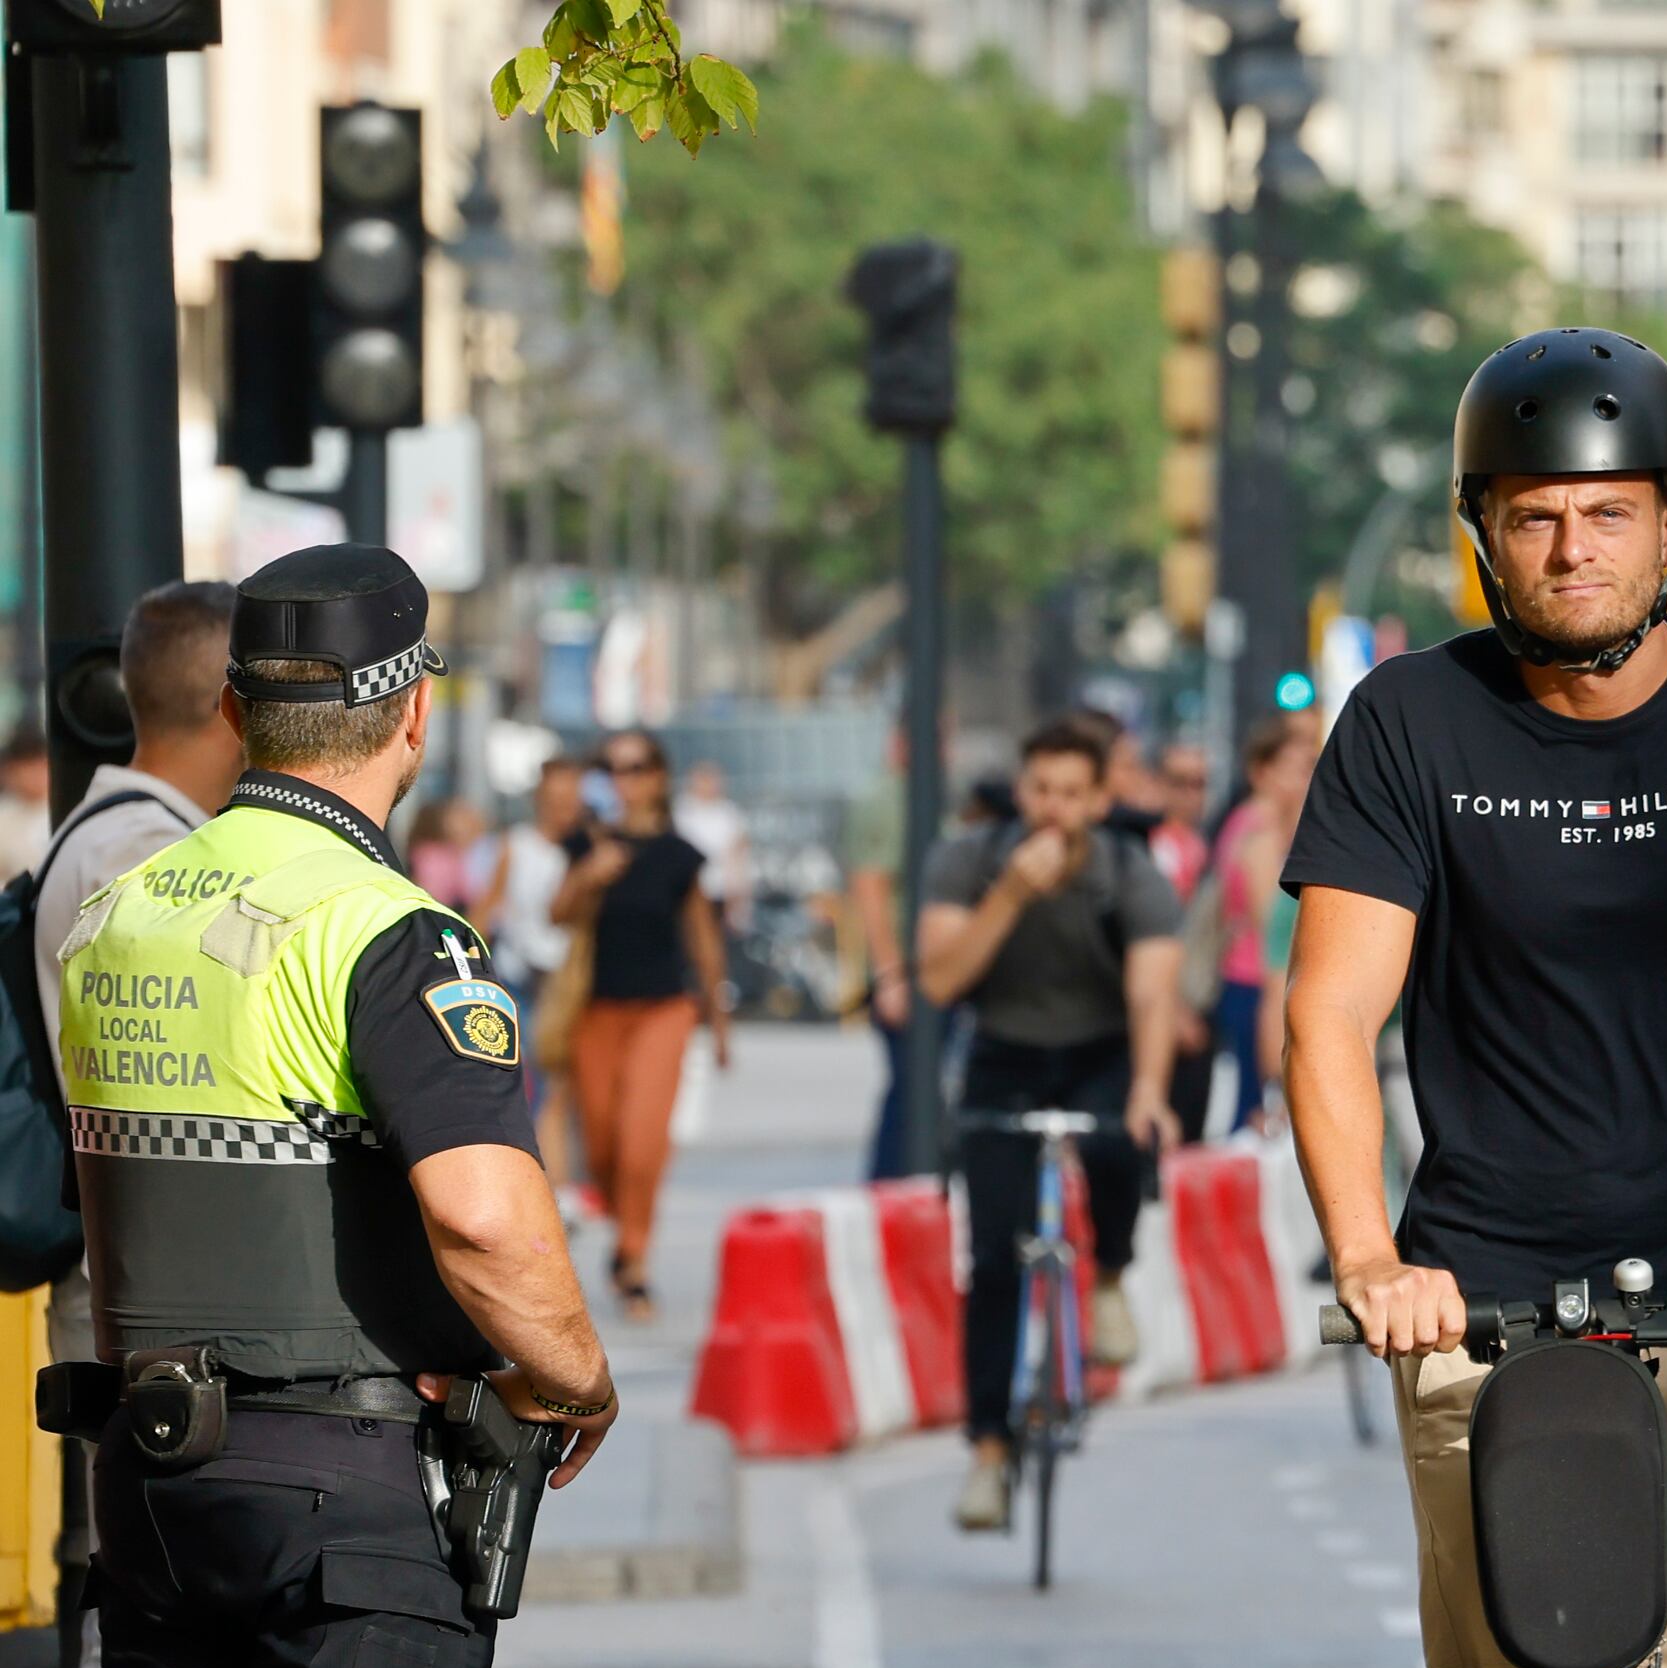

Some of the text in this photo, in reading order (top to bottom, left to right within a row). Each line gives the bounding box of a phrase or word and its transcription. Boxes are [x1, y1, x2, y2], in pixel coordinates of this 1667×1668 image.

[1451, 794, 1574, 818] TOMMY
[1560, 822, 1656, 844] EST. 1985
[80, 971, 199, 1010] POLICIA
[460, 985, 497, 1000] DSV
[99, 1016, 168, 1043] LOCAL
[71, 1046, 217, 1088] VALENCIA
